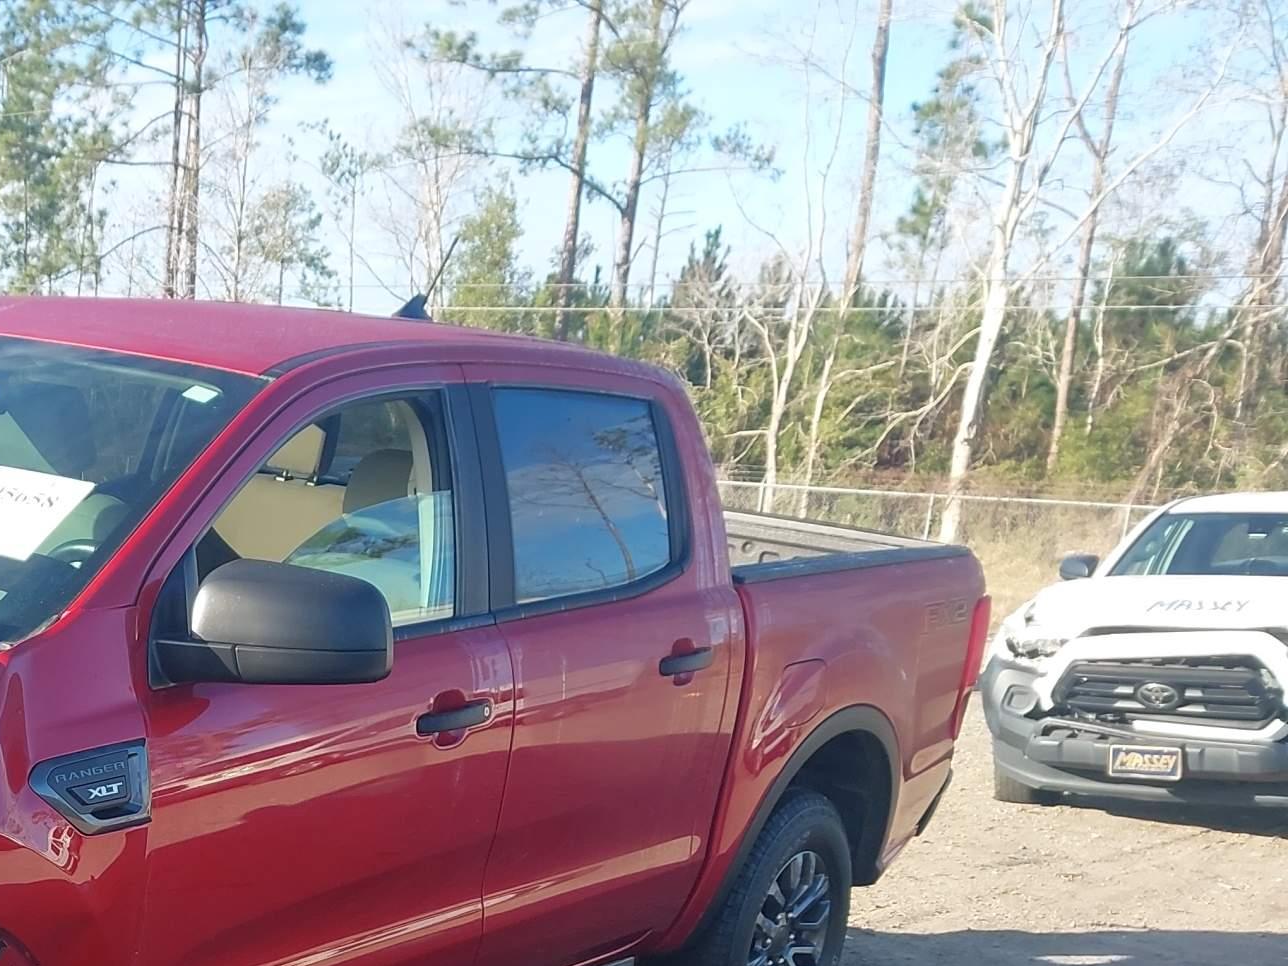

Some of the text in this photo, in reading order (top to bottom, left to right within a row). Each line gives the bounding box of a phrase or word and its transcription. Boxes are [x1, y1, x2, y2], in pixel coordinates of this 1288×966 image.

[1113, 751, 1177, 771] MASSEY
[55, 762, 125, 783] RANGER
[88, 782, 123, 799] XLT
